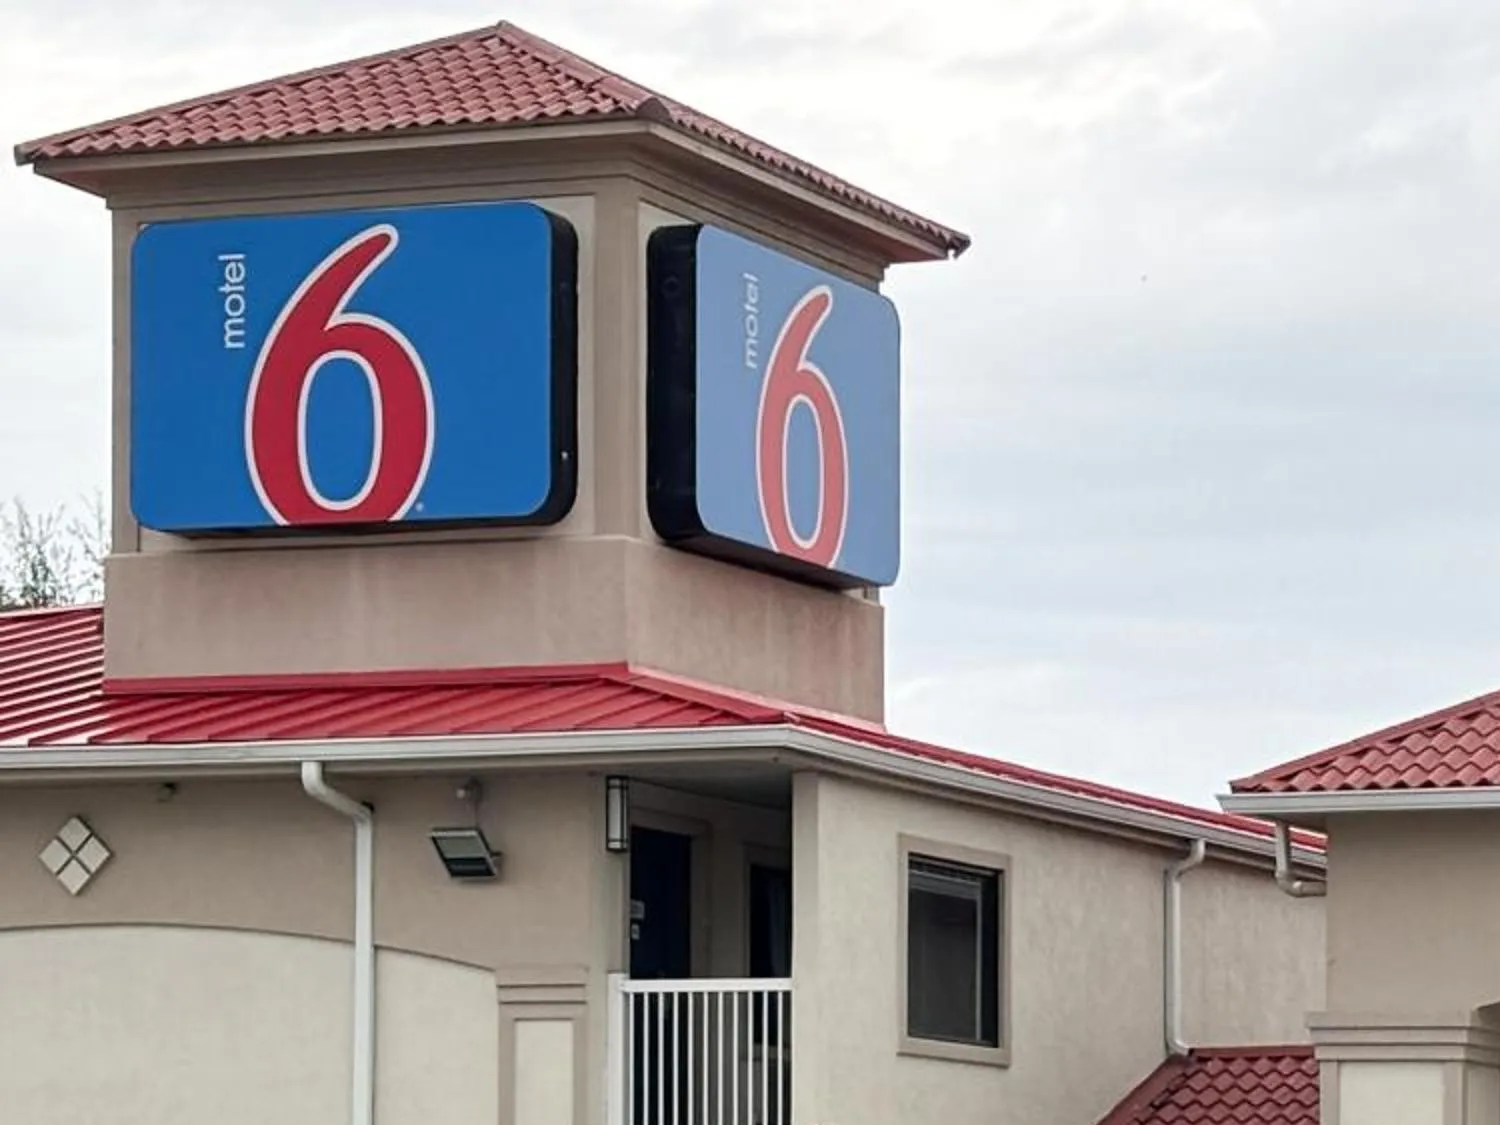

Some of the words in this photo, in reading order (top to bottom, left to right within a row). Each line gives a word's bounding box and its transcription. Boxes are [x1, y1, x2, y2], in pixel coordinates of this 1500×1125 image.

[217, 253, 246, 349] motel
[244, 224, 435, 525] 6
[743, 272, 758, 369] motel
[756, 284, 849, 568] 6
